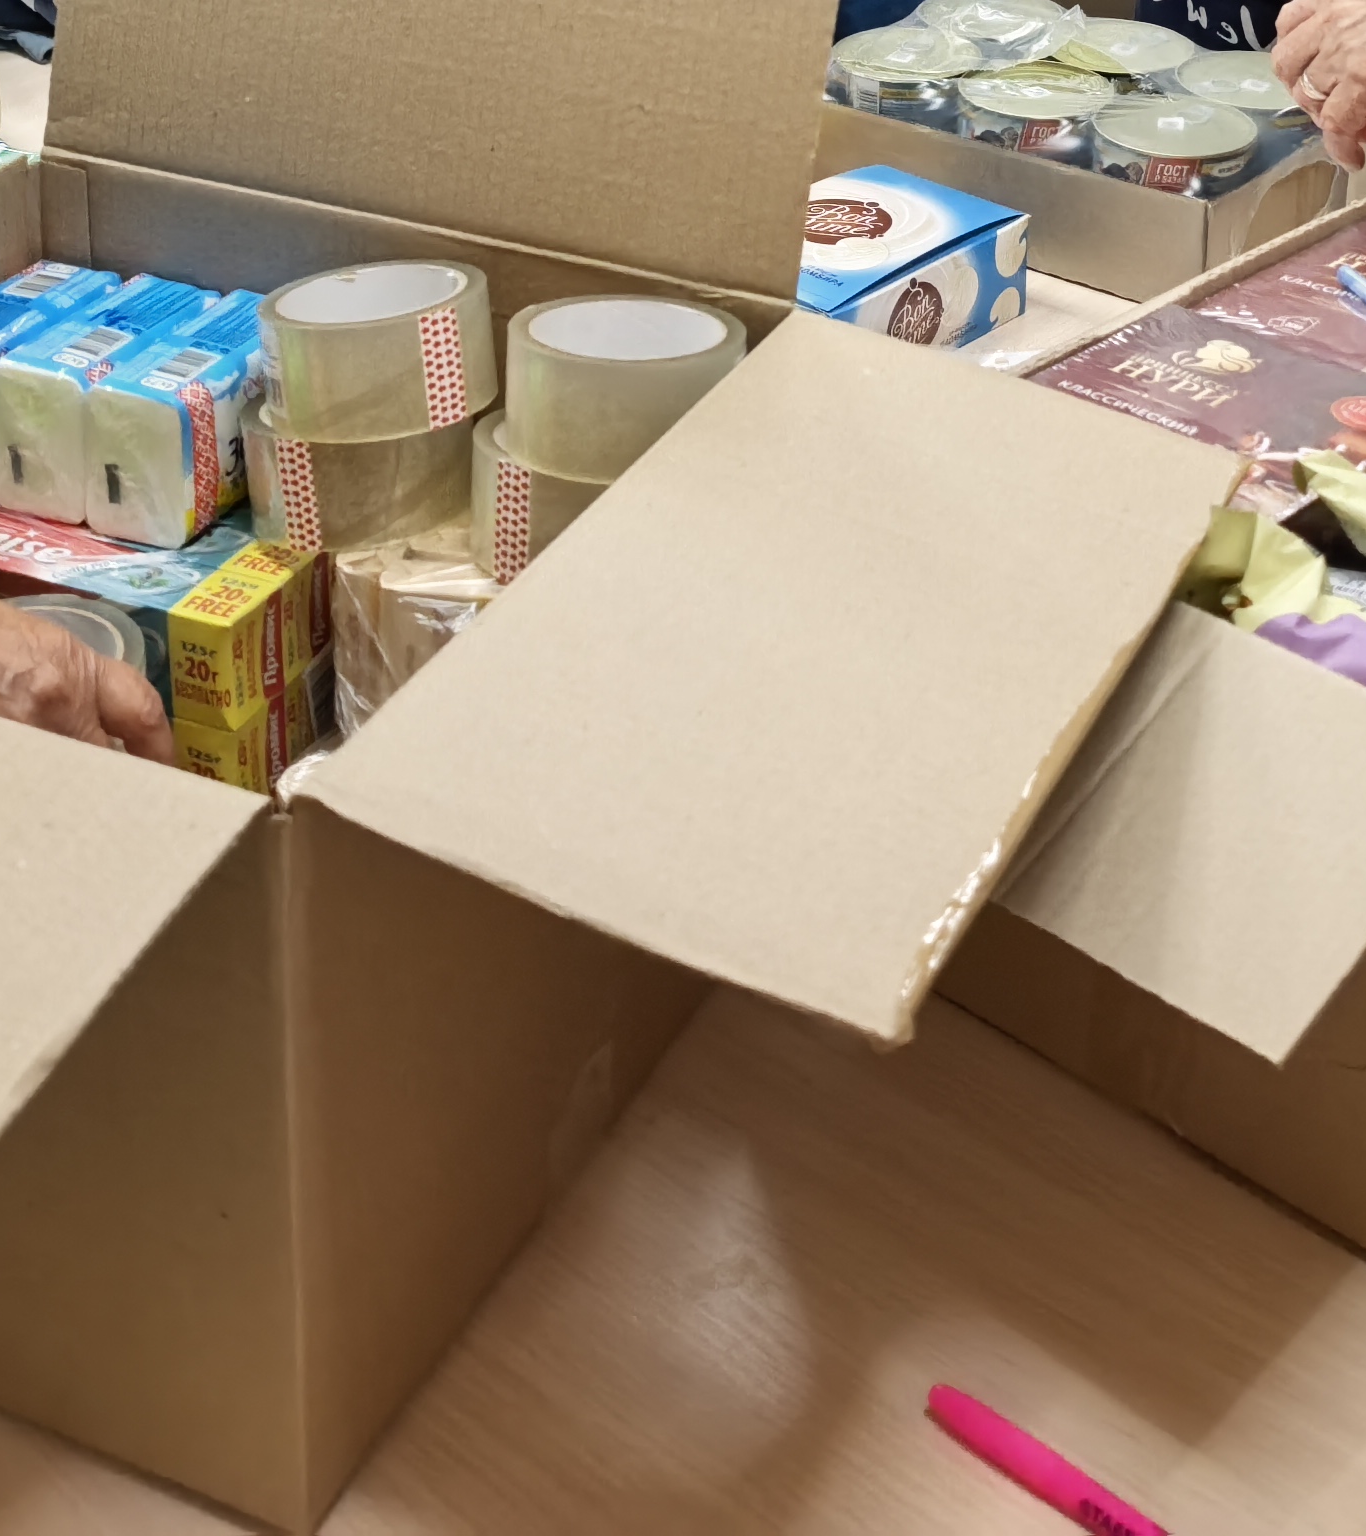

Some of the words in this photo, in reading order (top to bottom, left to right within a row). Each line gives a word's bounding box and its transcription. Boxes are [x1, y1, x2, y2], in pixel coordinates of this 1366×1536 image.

[1156, 164, 1191, 177] ГОСТ
[807, 204, 878, 224] Bon
[1107, 359, 1238, 408] НУРИ
[1057, 379, 1199, 437] КЛАССИЧЕСКИЙ
[236, 554, 287, 577] FREE
[183, 595, 242, 619] FREE
[263, 604, 278, 688] Промис
